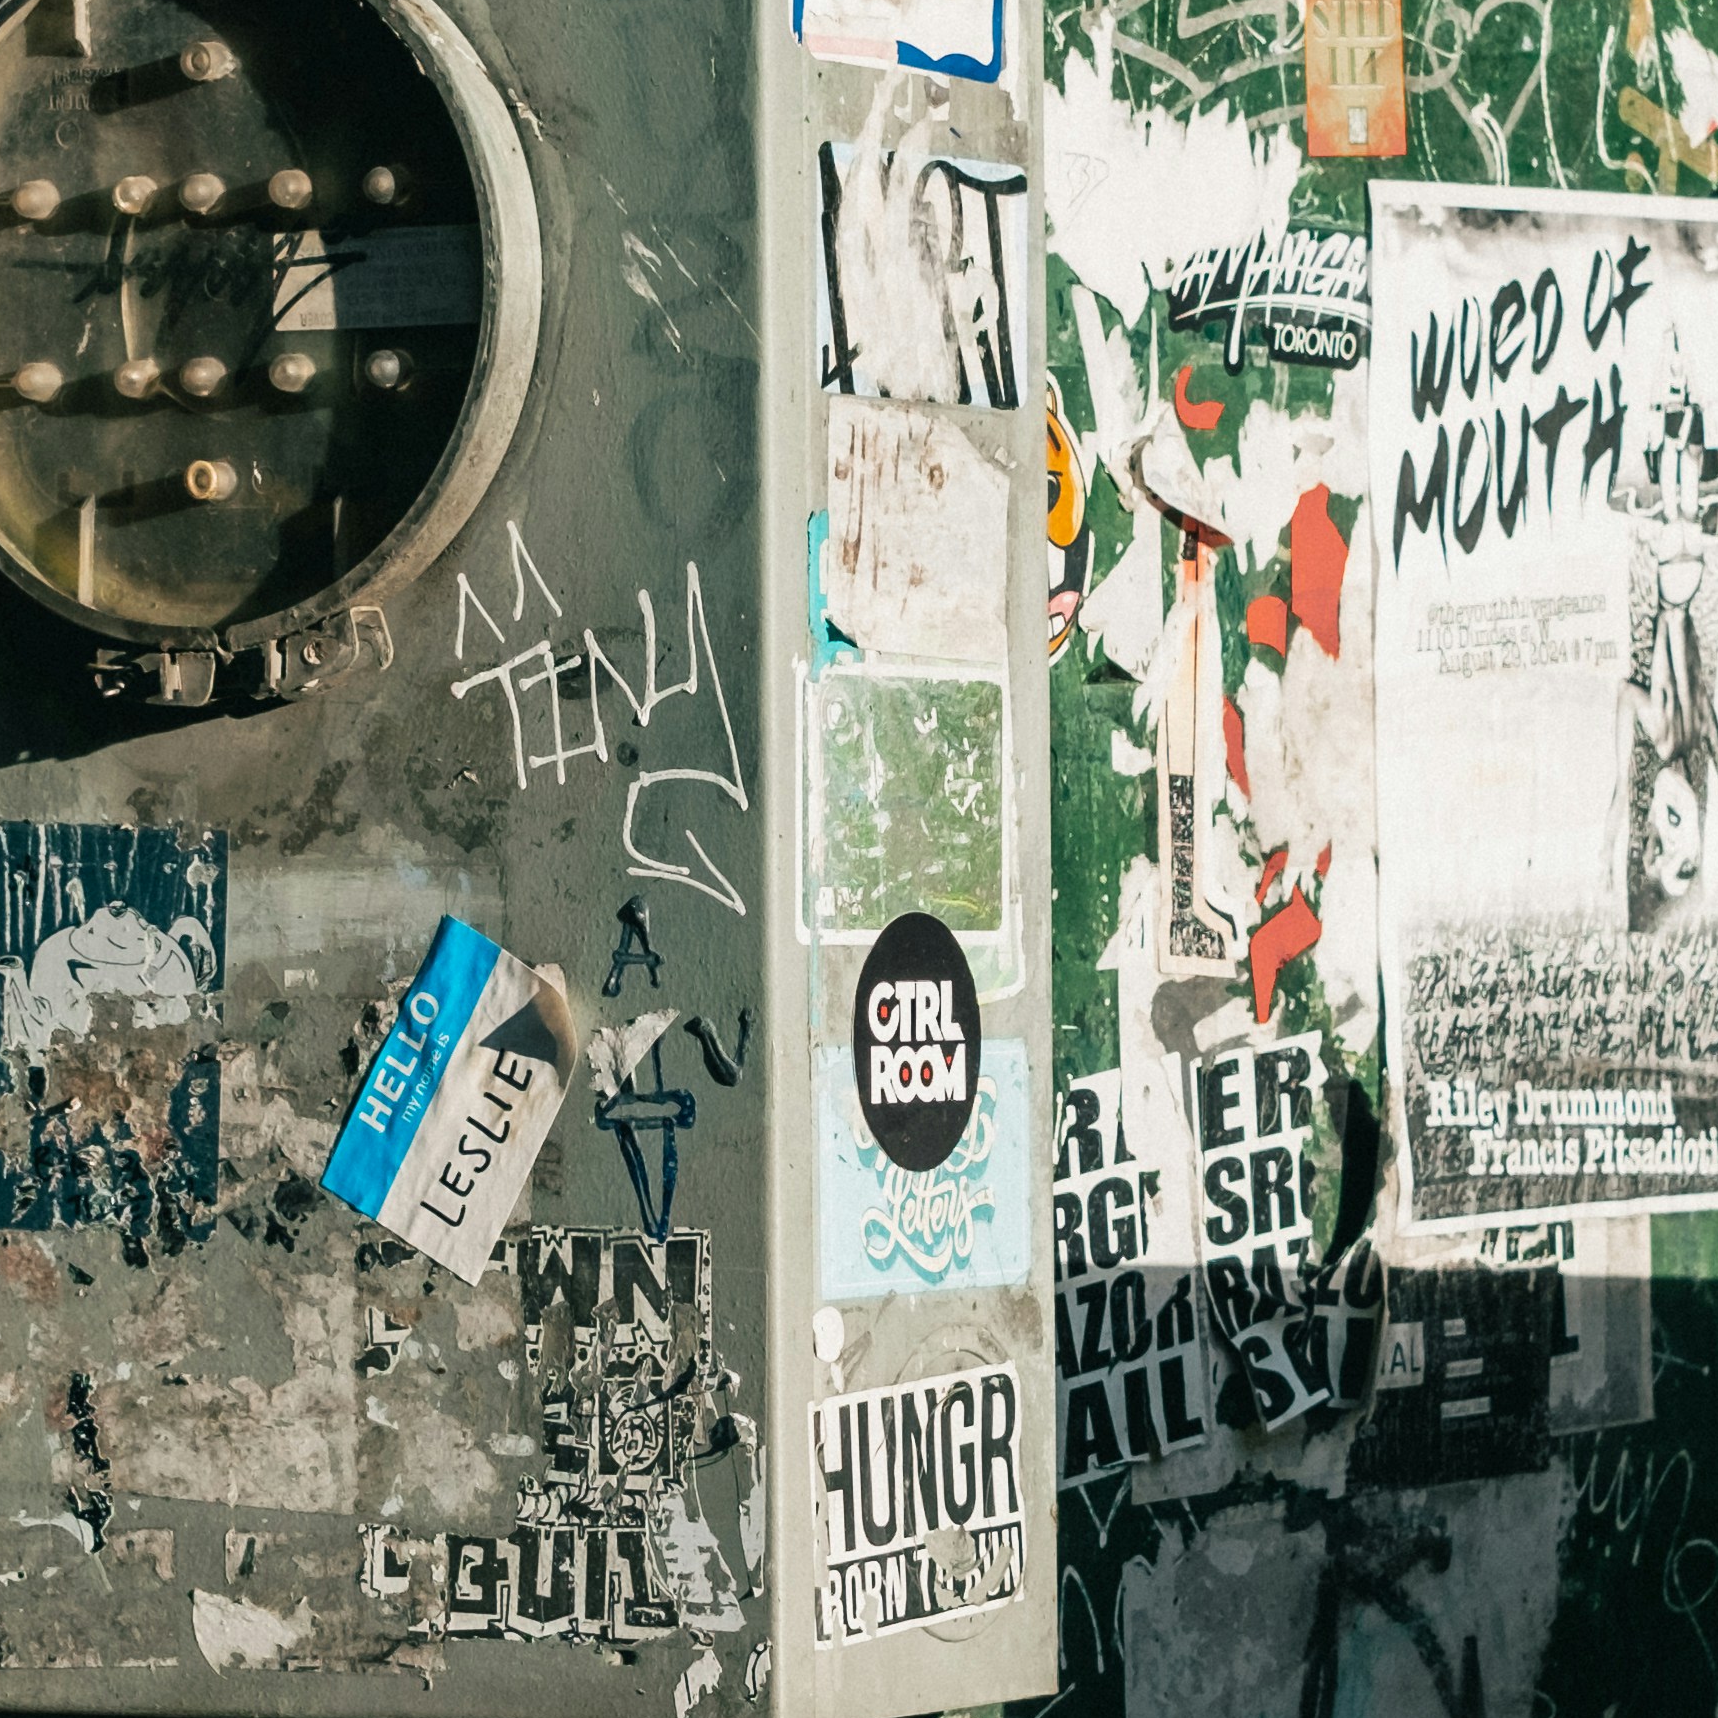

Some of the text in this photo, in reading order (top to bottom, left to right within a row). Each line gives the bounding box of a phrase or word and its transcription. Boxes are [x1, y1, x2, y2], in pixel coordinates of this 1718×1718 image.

[1273, 323, 1357, 361] TORONTO
[1393, 363, 1629, 580] MOUTH
[869, 980, 965, 1042] CTRL
[358, 990, 441, 1136] HELLO
[401, 1031, 451, 1125] my name is
[870, 1042, 967, 1105] ROOM
[419, 1048, 533, 1228] LESLIE
[1425, 1079, 1675, 1138] Riley Drummond
[1469, 1129, 1580, 1176] Francis
[1053, 1171, 1148, 1281] RG
